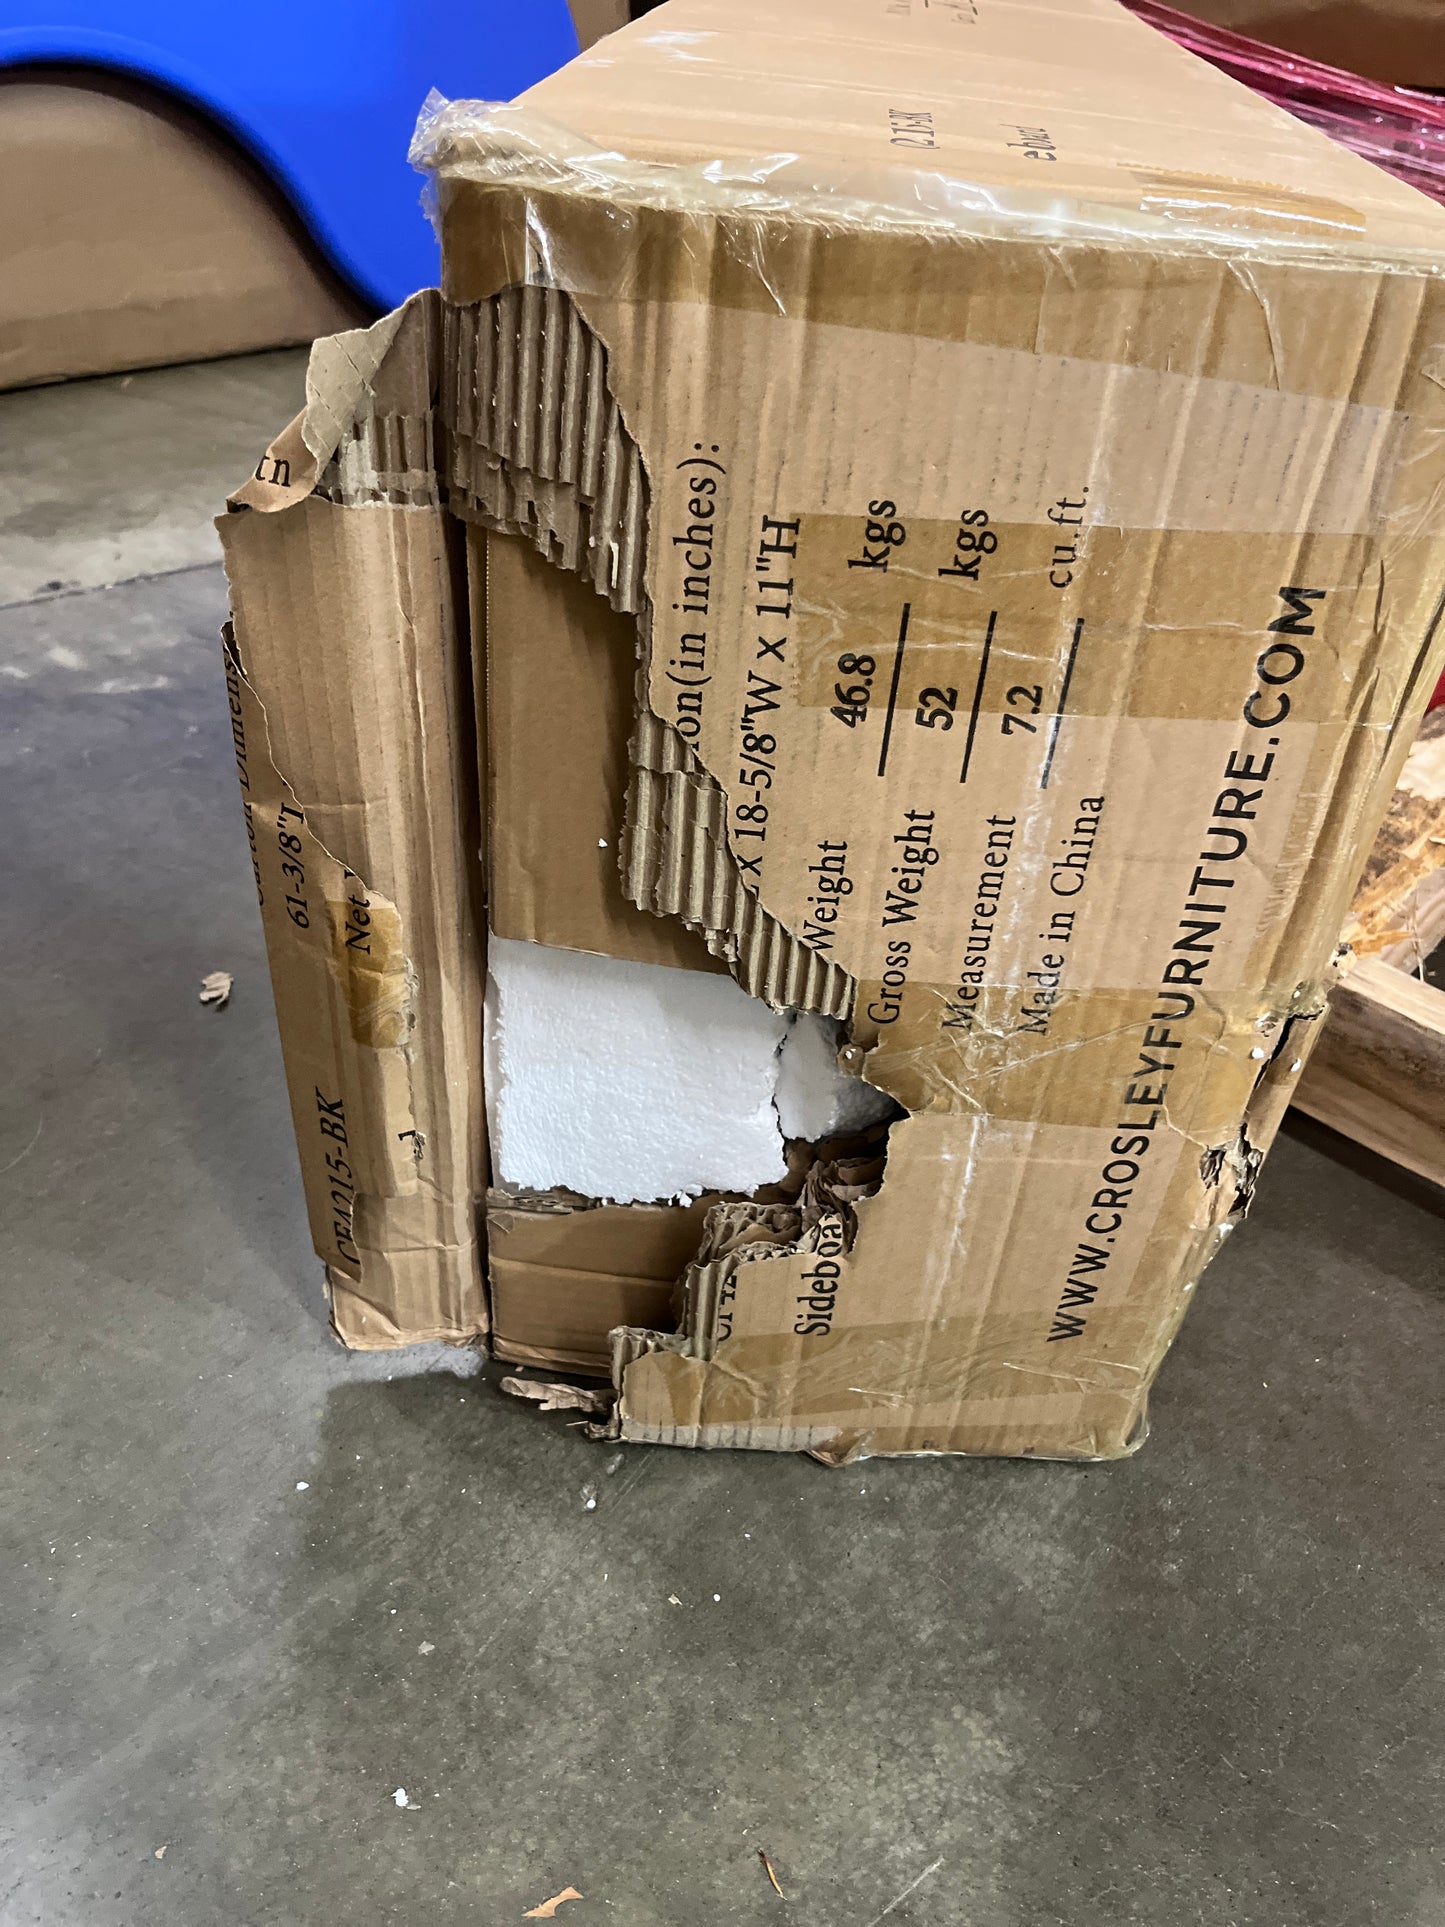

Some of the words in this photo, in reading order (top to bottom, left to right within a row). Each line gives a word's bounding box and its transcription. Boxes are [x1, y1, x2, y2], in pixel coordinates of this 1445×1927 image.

[672, 443, 726, 616] inches):
[755, 515, 801, 619] 11"H
[848, 500, 906, 573] kgs
[938, 509, 998, 580] kgs
[756, 636, 787, 662] x
[830, 653, 876, 728] 46.8
[915, 687, 958, 730] 52
[735, 669, 782, 842] 18-5/8"W
[942, 815, 1016, 1030] Measurement
[1001, 685, 1043, 735] 7.2
[1047, 486, 1089, 588] cu.ft.
[882, 809, 939, 927] Weight
[1050, 796, 1105, 896] China
[344, 894, 371, 955] Net
[803, 840, 853, 951] Weight
[1039, 911, 1075, 943] in
[867, 940, 911, 1024] Gross
[1017, 954, 1064, 1036] Made
[1046, 585, 1327, 1342] WWW.CROSLEYFURNITURE.COM
